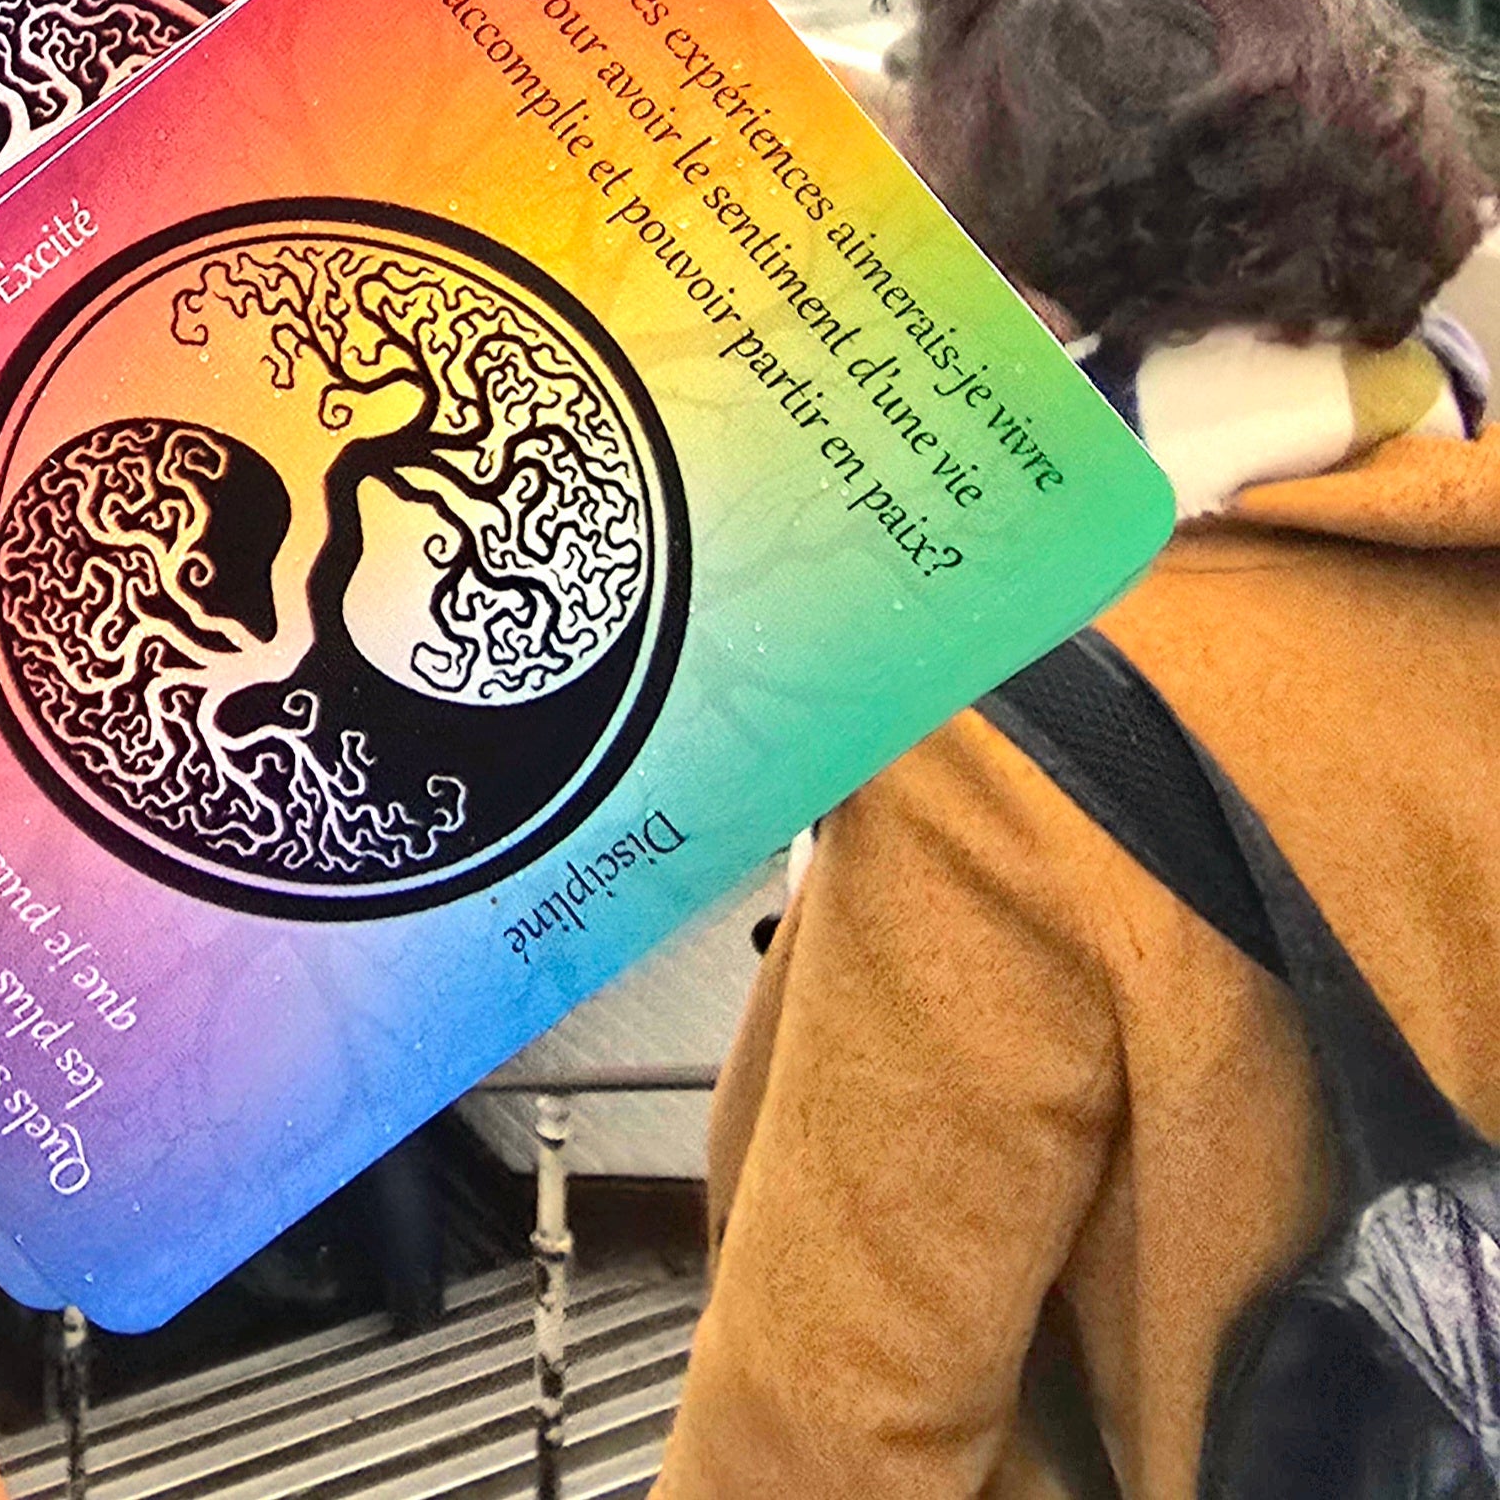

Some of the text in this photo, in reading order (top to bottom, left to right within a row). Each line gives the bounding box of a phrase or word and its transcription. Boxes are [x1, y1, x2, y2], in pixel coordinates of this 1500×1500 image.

[586, 159, 634, 199] et
[596, 60, 683, 144] avoir
[671, 135, 714, 186] le
[701, 185, 863, 359] sentiment
[846, 355, 939, 456] d'une
[930, 449, 984, 509] vie
[604, 193, 743, 325] pouvoir
[663, 27, 835, 222] expériences
[825, 221, 994, 409] aimerais-je
[986, 402, 1064, 493] vivre
[717, 326, 831, 430] partir
[819, 435, 866, 486] en
[845, 478, 964, 578] paix?
[503, 810, 688, 965] Discipliné
[42, 930, 92, 974] je
[71, 950, 138, 1032] que
[54, 1047, 105, 1111] les
[0, 1088, 92, 1196] Quels
